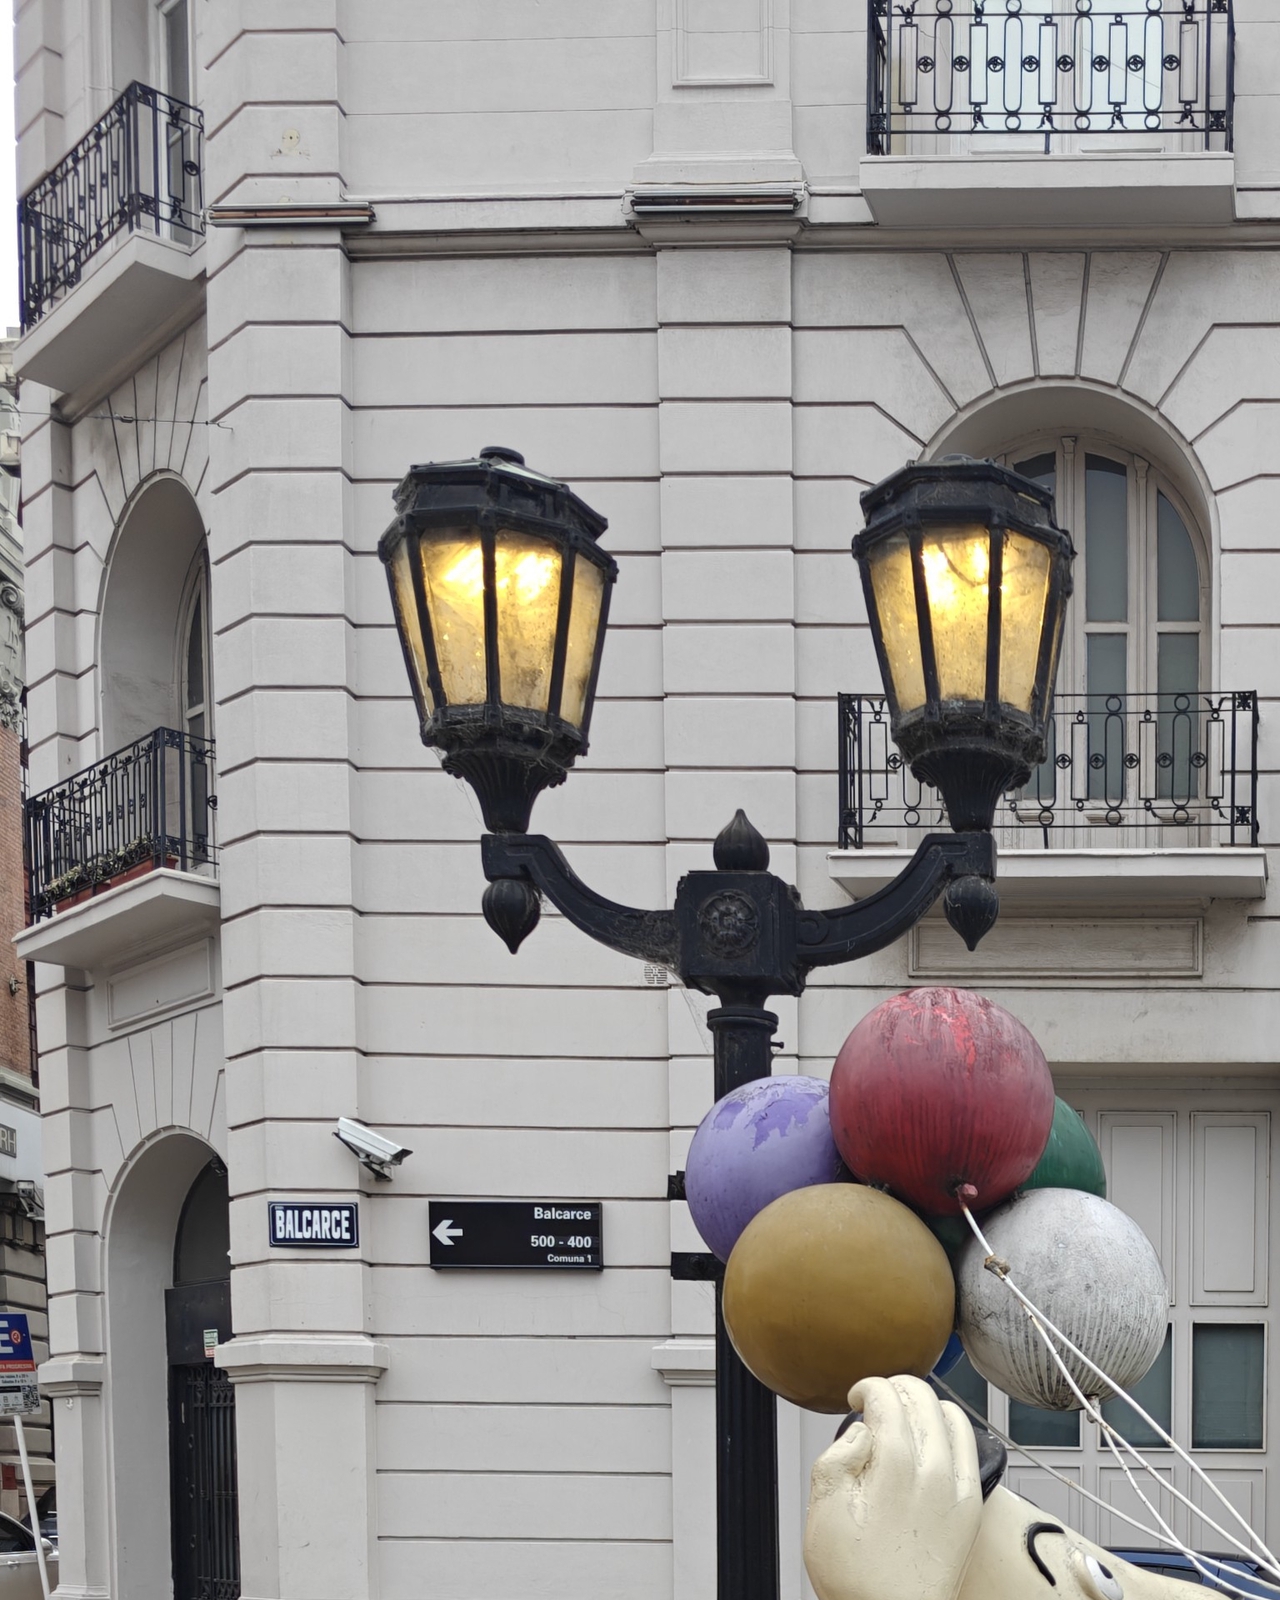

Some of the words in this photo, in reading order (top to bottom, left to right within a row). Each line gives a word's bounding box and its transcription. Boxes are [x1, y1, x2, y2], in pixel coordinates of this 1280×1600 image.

[534, 1206, 592, 1220] Balcarce
[275, 1210, 351, 1240] BALCARCE
[531, 1235, 555, 1247] 500
[567, 1236, 592, 1248] 400
[547, 1254, 585, 1263] Comuna
[586, 1254, 592, 1263] 1
